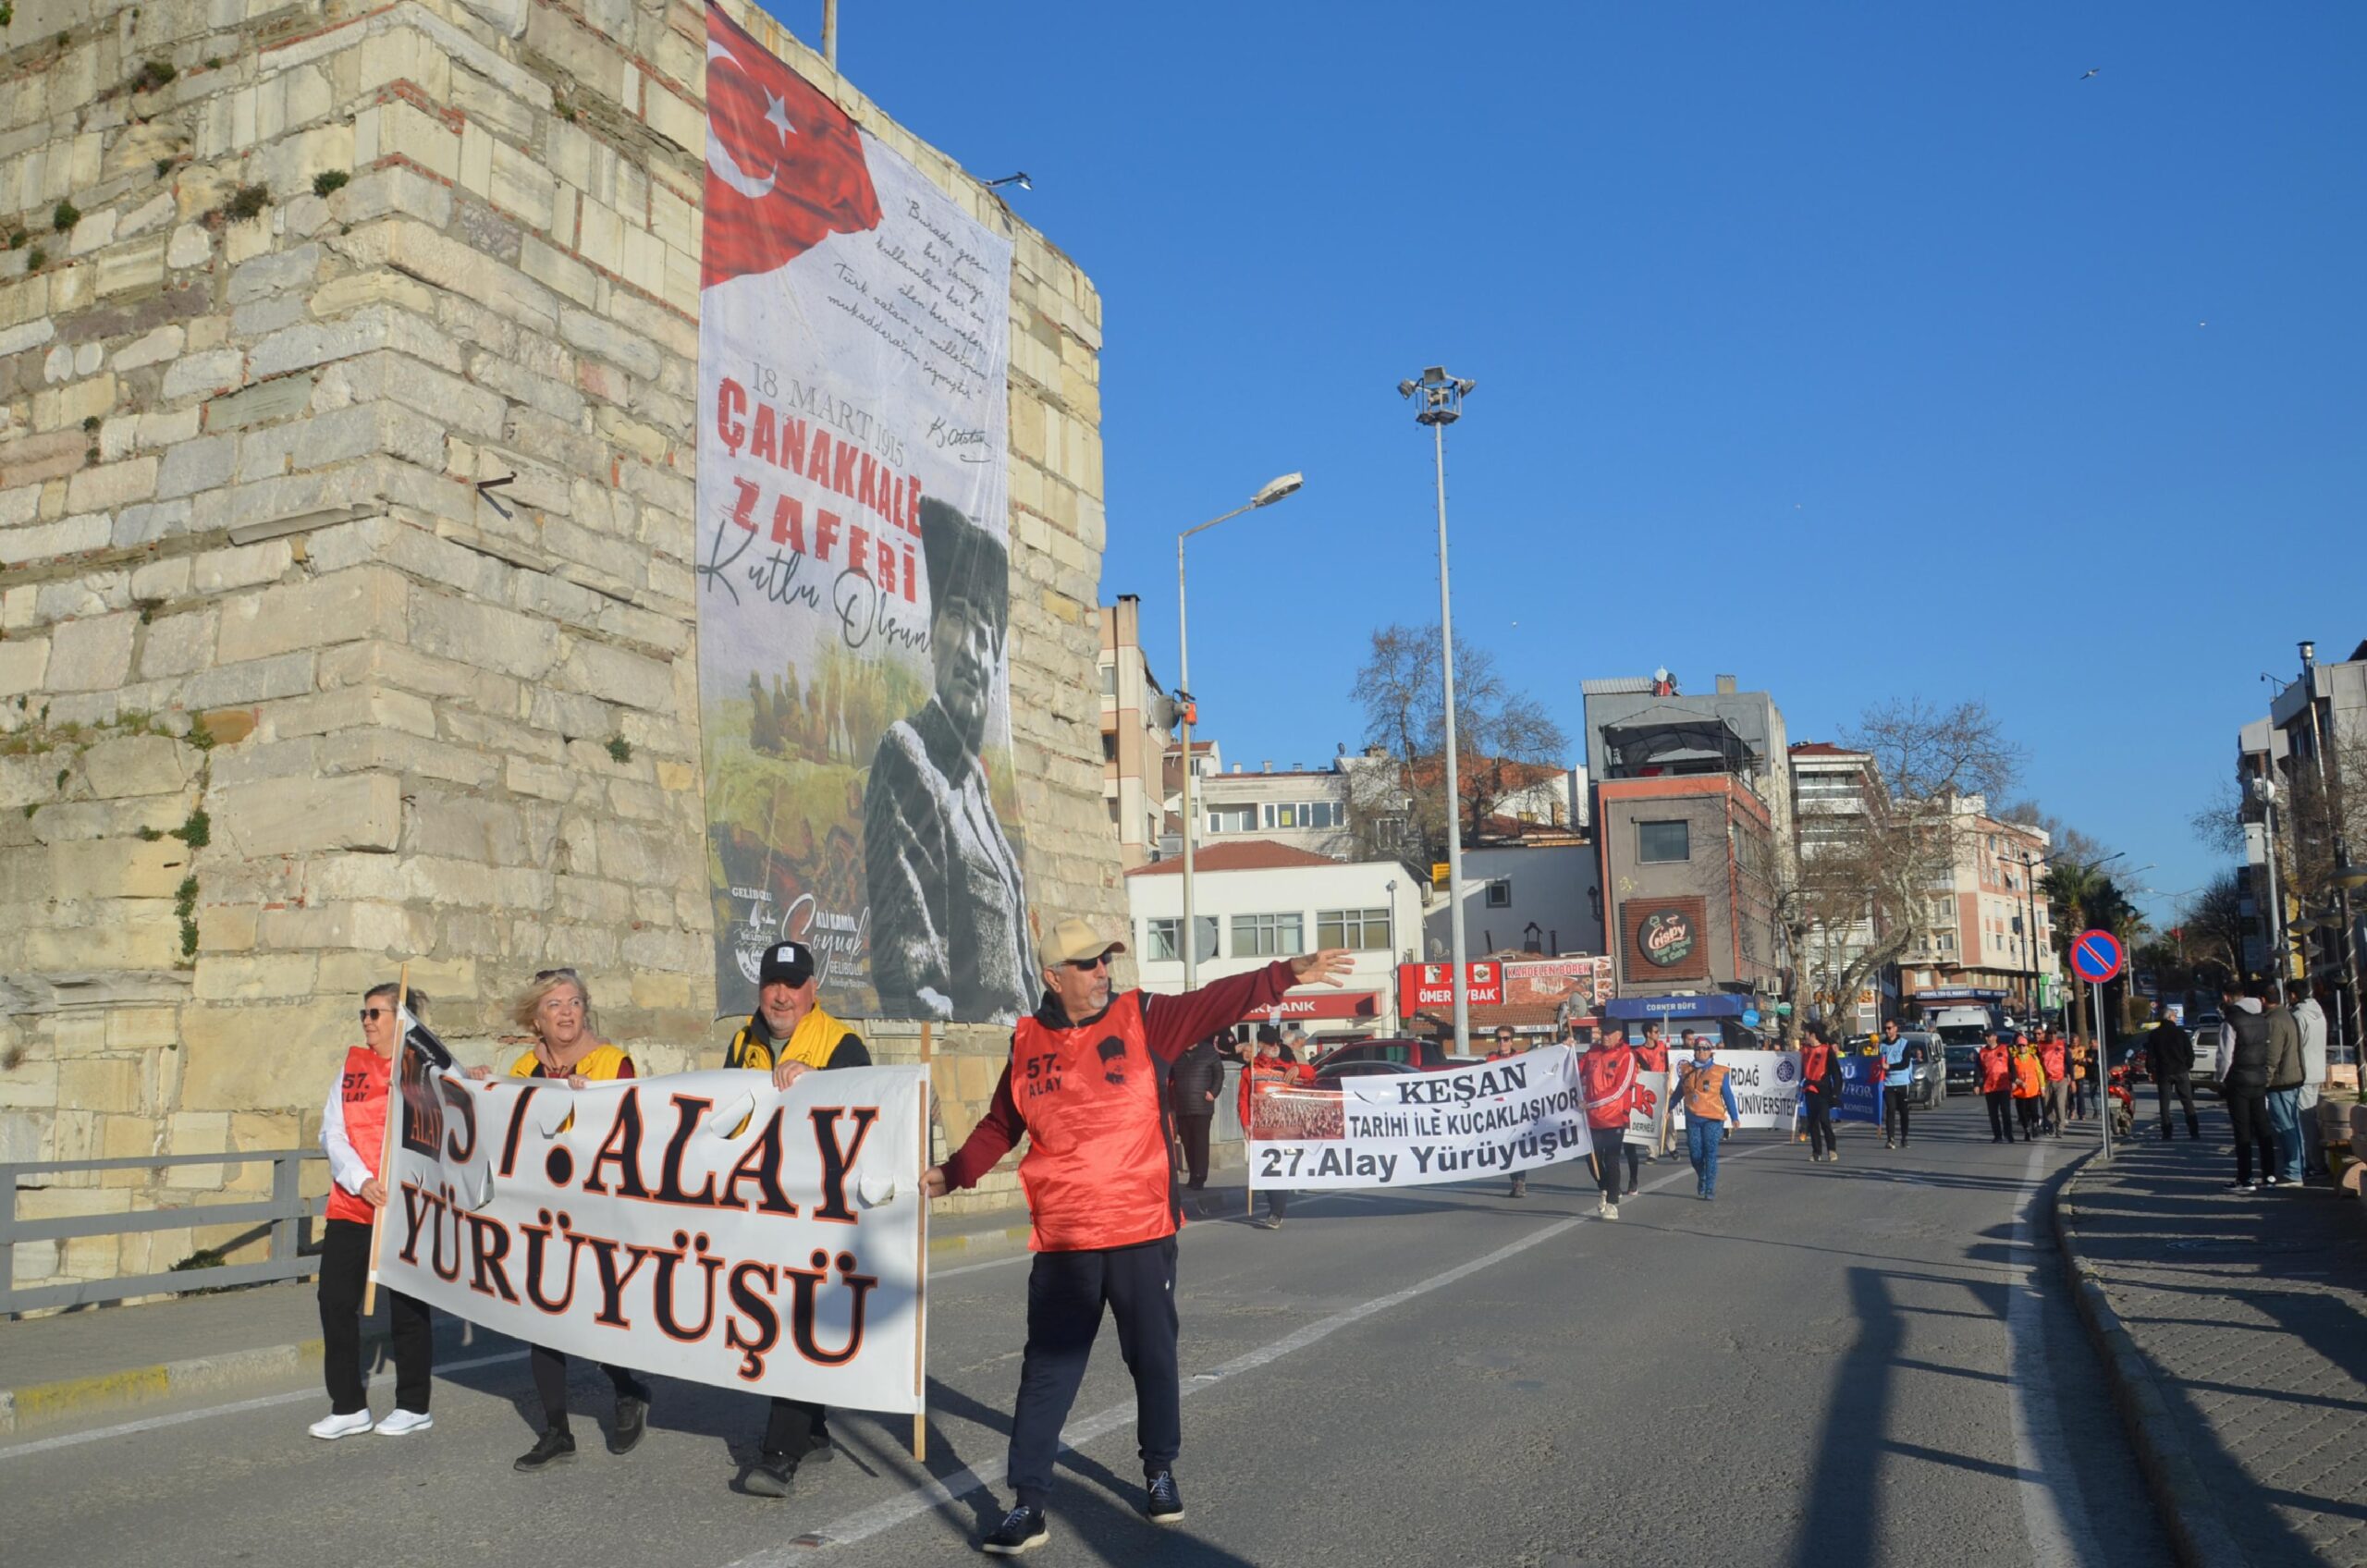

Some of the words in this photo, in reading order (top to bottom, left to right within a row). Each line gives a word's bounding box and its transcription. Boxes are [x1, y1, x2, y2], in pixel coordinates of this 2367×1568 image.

[753, 361, 779, 398] 18
[789, 379, 873, 441] MART
[876, 423, 904, 468] 1915
[717, 377, 922, 539] ÇANAKKALE
[732, 476, 917, 604] ZAFERİ
[697, 520, 820, 607] Kutlu
[834, 568, 930, 653] Olsun
[1649, 924, 1686, 949] Crispy
[1419, 988, 1452, 1002] ÖMER
[1646, 1003, 1675, 1011] CORNER
[1026, 1053, 1061, 1080] 57.
[1029, 1075, 1061, 1099] ALAY
[1397, 1062, 1527, 1108] KEŞAN
[1727, 1062, 1760, 1087] RDAĞ
[1350, 1111, 1408, 1137] TARİHİ
[1415, 1110, 1441, 1136] İLE
[1447, 1087, 1579, 1135] KUCAKLAŞIYOR
[1738, 1093, 1797, 1115] ÜNİVERSİTES
[1410, 1120, 1579, 1174] Yürüyüşü
[399, 1181, 877, 1381] YÜRÜYÜŞÜ
